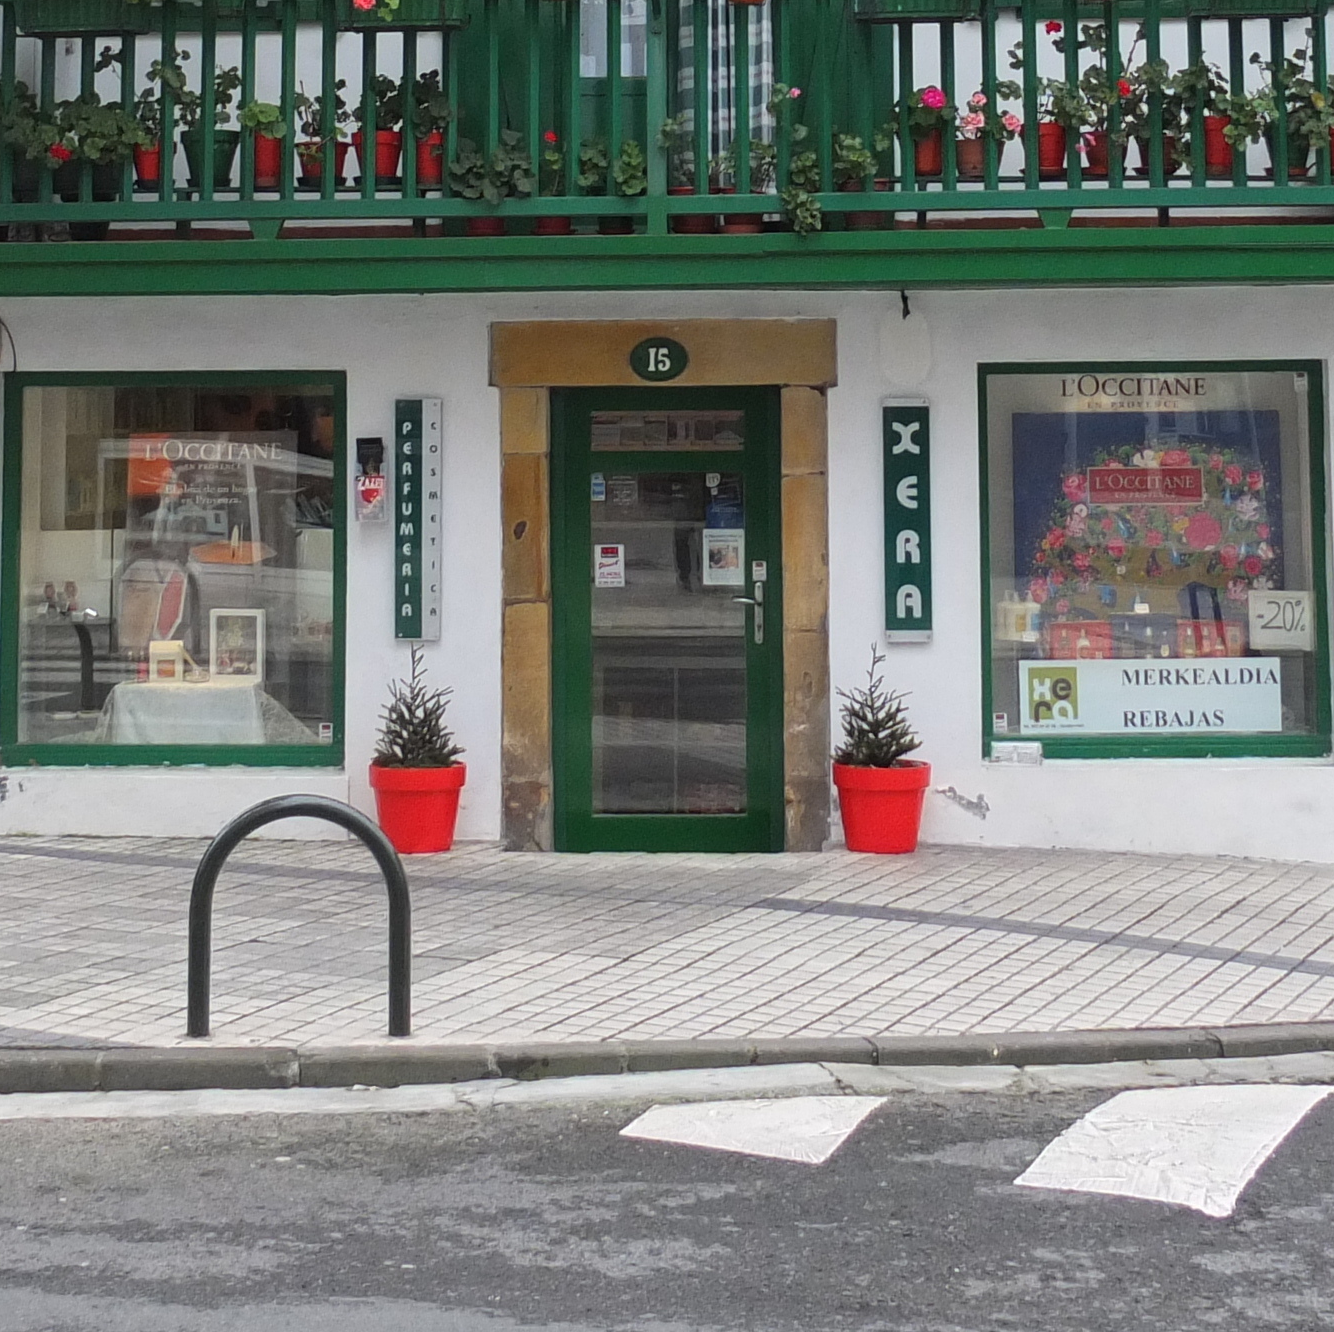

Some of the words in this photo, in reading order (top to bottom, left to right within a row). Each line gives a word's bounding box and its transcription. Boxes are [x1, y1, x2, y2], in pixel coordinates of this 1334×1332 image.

[647, 347, 671, 372] 15
[399, 421, 414, 617] PERFUMERIA
[891, 420, 923, 620] XERA
[1255, 599, 1306, 632] -20%
[1121, 667, 1279, 687] MERKEALDIA
[1123, 709, 1226, 729] REBAJAS
